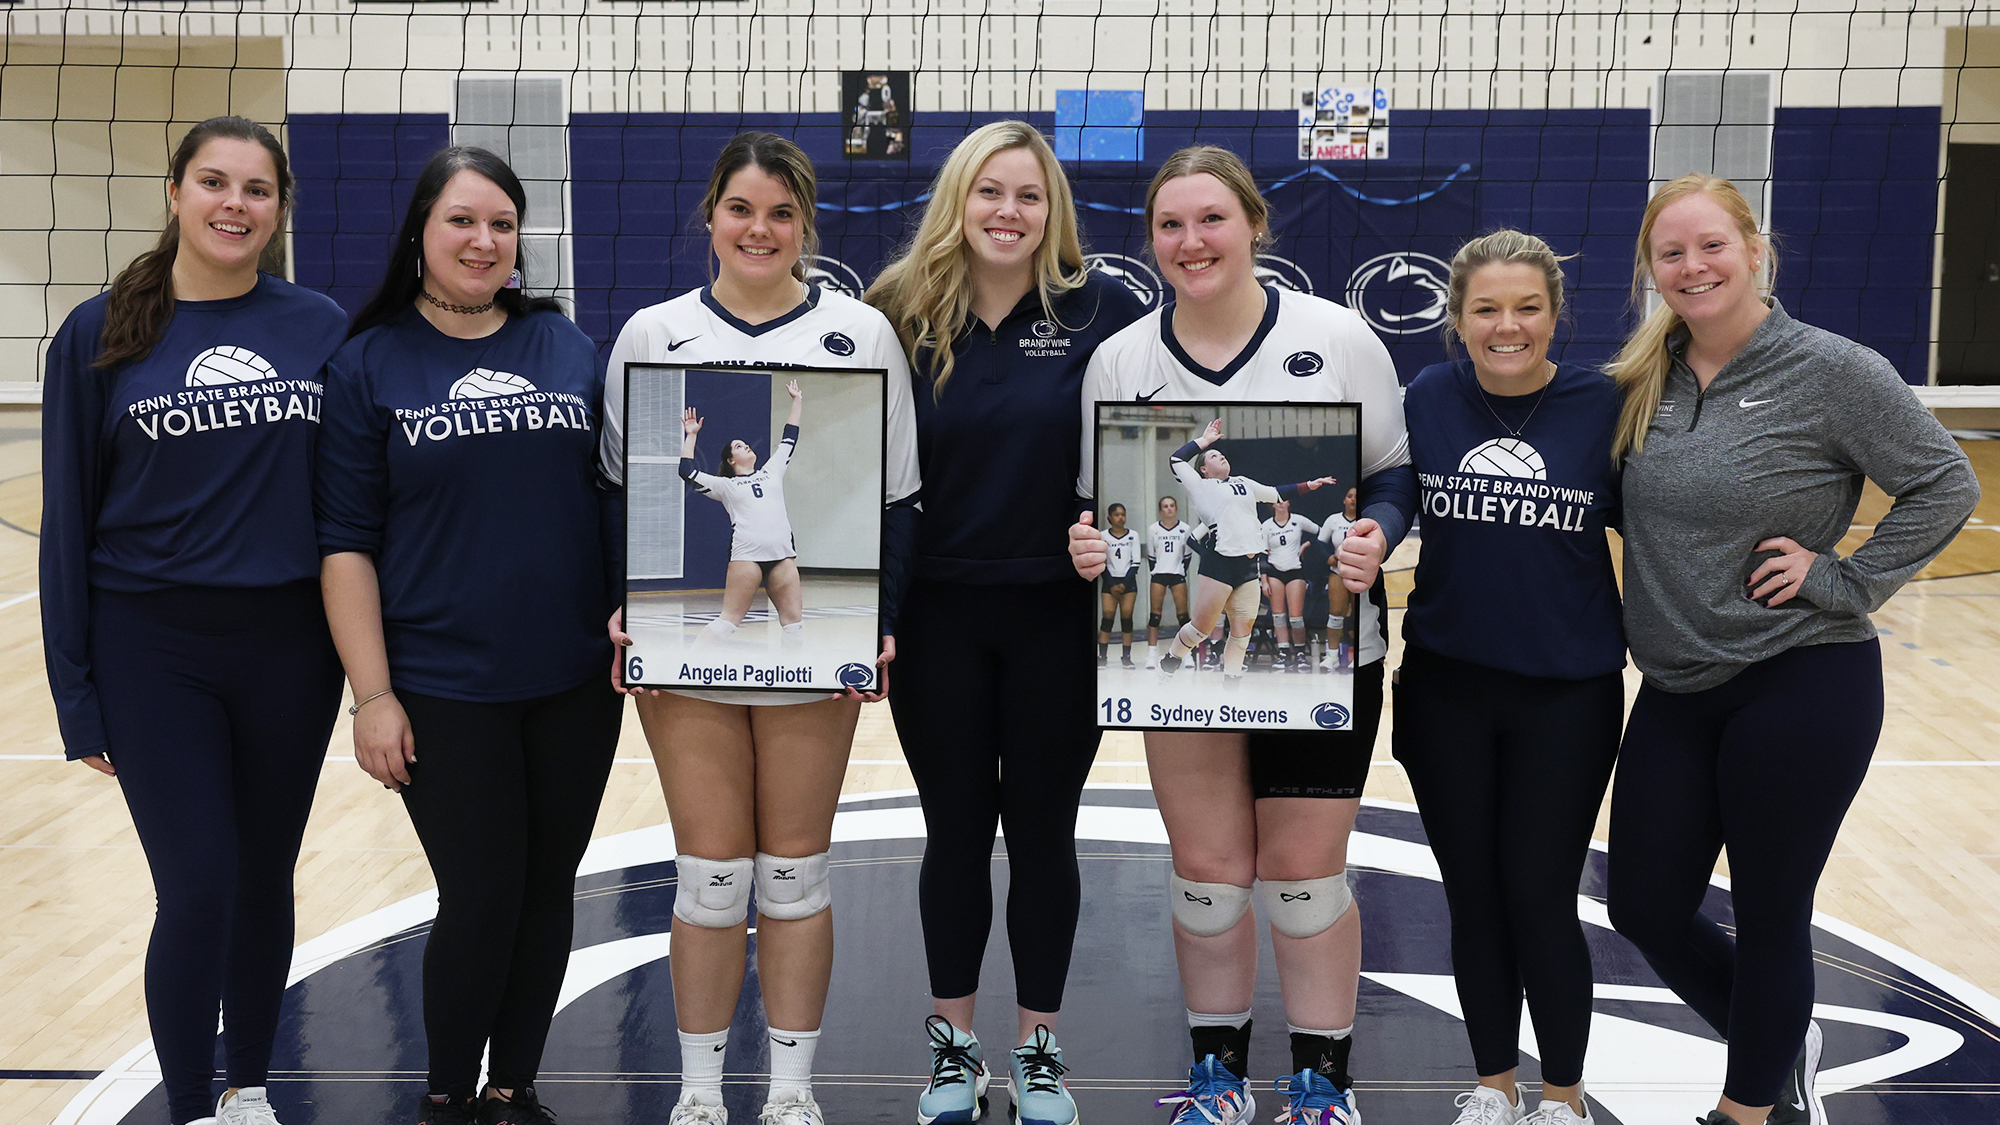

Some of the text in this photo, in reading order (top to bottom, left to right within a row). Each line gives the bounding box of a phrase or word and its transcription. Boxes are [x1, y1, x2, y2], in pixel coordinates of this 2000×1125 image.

[1316, 144, 1368, 159] ANGELA
[1019, 338, 1071, 347] BRANDYWINE
[128, 380, 325, 417] PENN STATE BRANDYWINE
[395, 392, 586, 421] PENN STATE BRANDYWINE
[136, 394, 321, 440] VOLLEYBALL
[402, 404, 591, 446] VOLLEYBALL
[751, 483, 764, 498] 6
[1229, 483, 1247, 496] 18
[1418, 473, 1595, 505] PENN STATE BRANDYWINE
[1421, 489, 1585, 532] VOLLEYBALL
[1115, 548, 1121, 559] 4
[1164, 541, 1174, 553] 21
[1280, 535, 1287, 546] 8
[628, 656, 813, 686] 6 Angela Pagliotti
[1101, 697, 1288, 726] 18 Sydney Stevens
